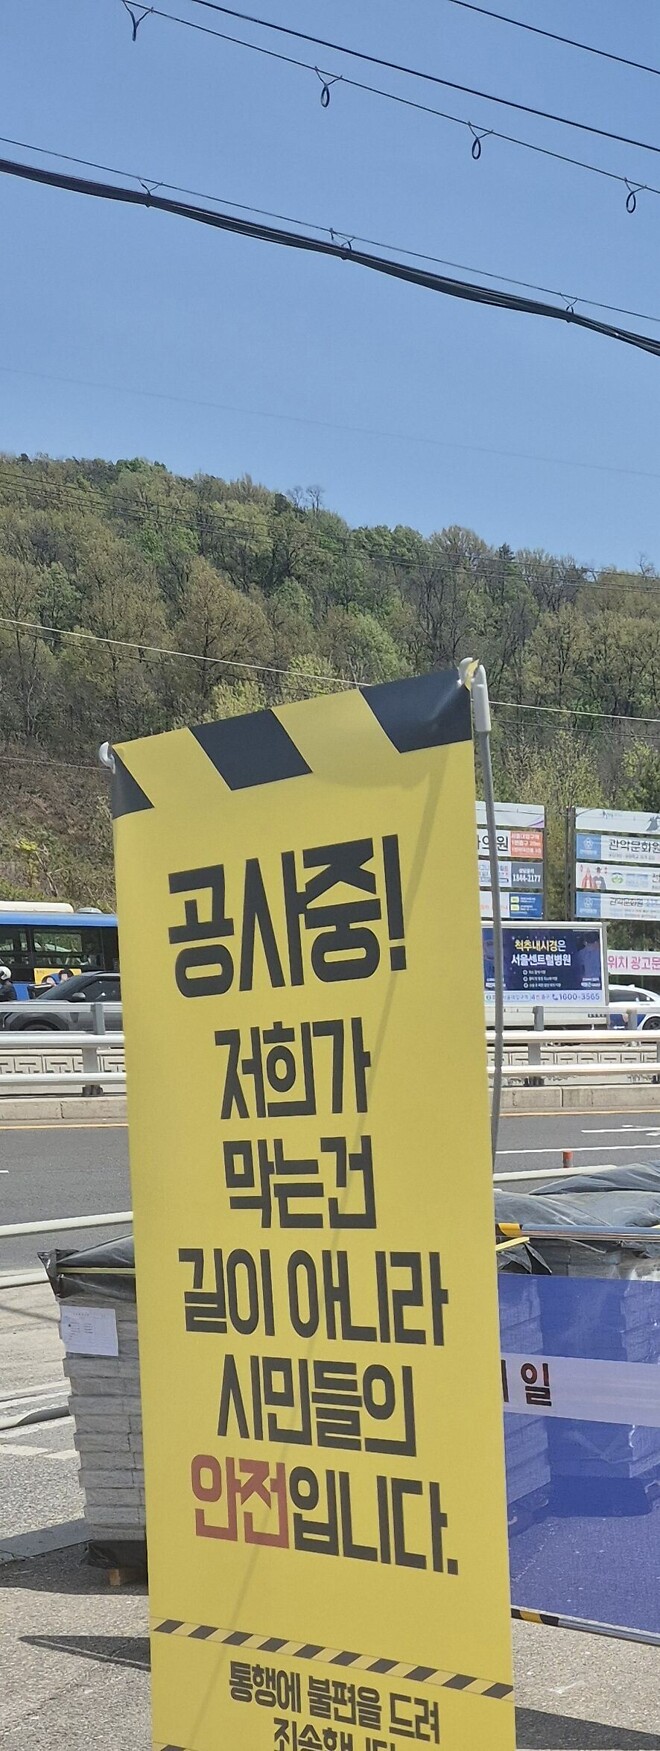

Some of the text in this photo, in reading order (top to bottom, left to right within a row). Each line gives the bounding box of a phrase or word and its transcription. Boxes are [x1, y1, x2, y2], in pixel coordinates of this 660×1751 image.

[168, 834, 407, 998] 공사중!
[511, 953, 571, 967] 서울센트럴병원
[514, 939, 567, 952] 척추내시경은
[214, 1016, 372, 1120] 저희가
[222, 1134, 377, 1230] 막는건
[178, 1248, 449, 1347] 길이 아니라
[217, 1354, 417, 1457] 시민들의
[191, 1453, 459, 1576] 안전입니다.
[229, 1660, 441, 1745] 통행에 불편을 드려
